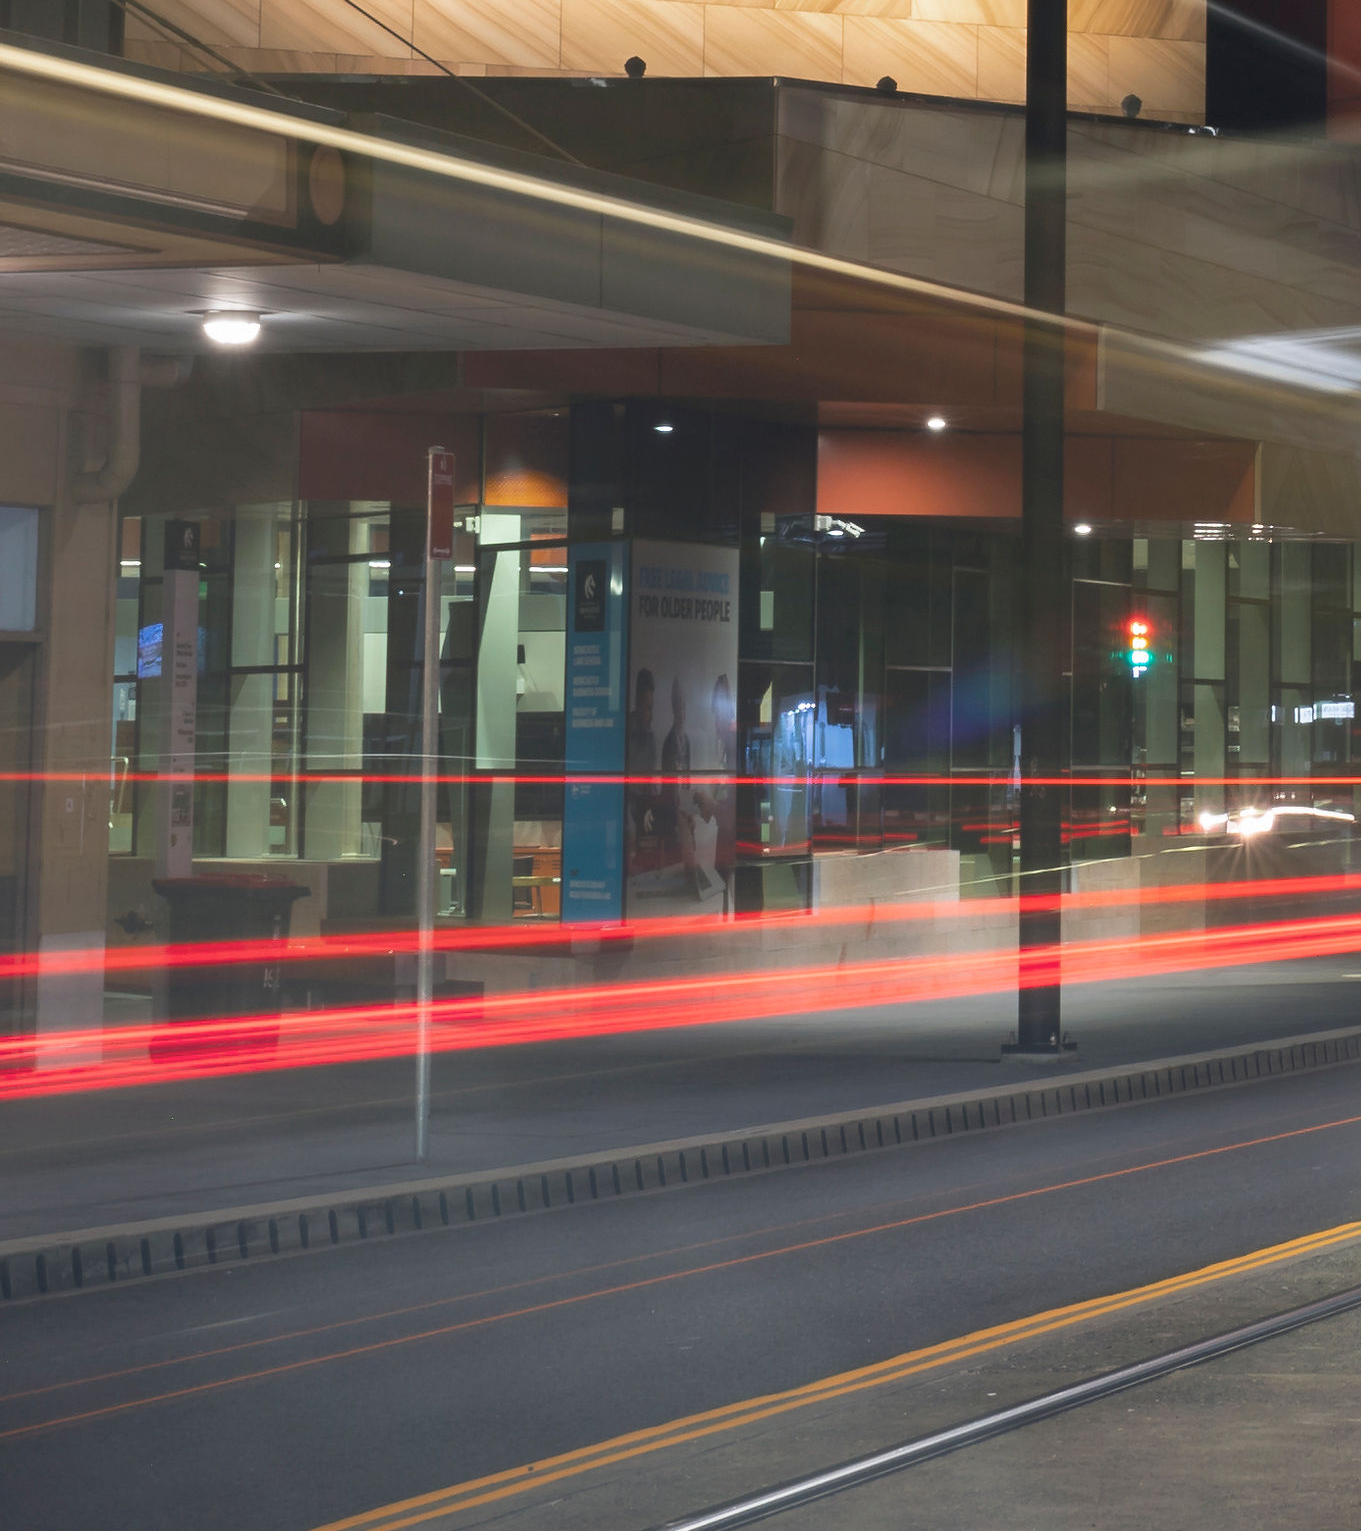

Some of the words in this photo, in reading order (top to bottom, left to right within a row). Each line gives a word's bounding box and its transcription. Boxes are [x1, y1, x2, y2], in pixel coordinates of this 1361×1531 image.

[639, 595, 659, 618] FOR
[661, 596, 693, 620] OLDER
[695, 598, 730, 622] PEOPLE
